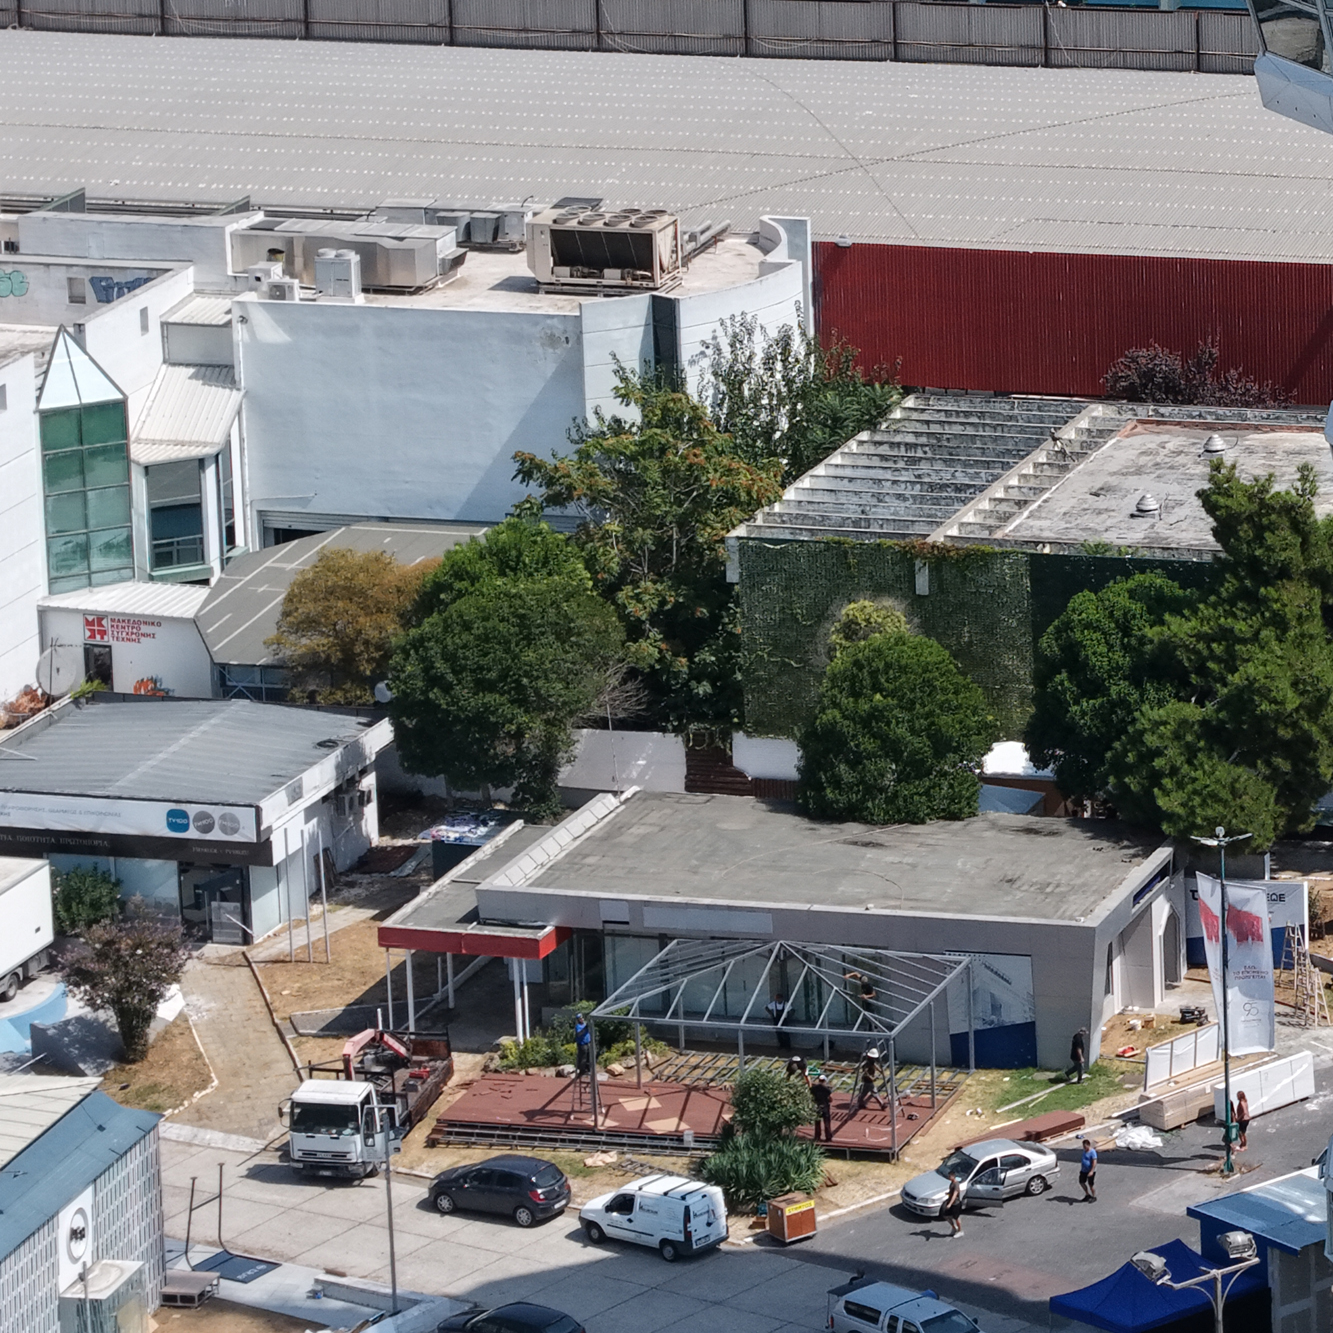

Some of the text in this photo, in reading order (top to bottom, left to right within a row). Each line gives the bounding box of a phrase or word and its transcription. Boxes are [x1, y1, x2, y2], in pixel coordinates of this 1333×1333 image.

[110, 618, 162, 627] ΜΑΚΕΔΟΝΙΚΟ
[111, 630, 156, 639] ΣΥΓΧΡΟΝΗΣ
[1243, 1002, 1259, 1016] 95
